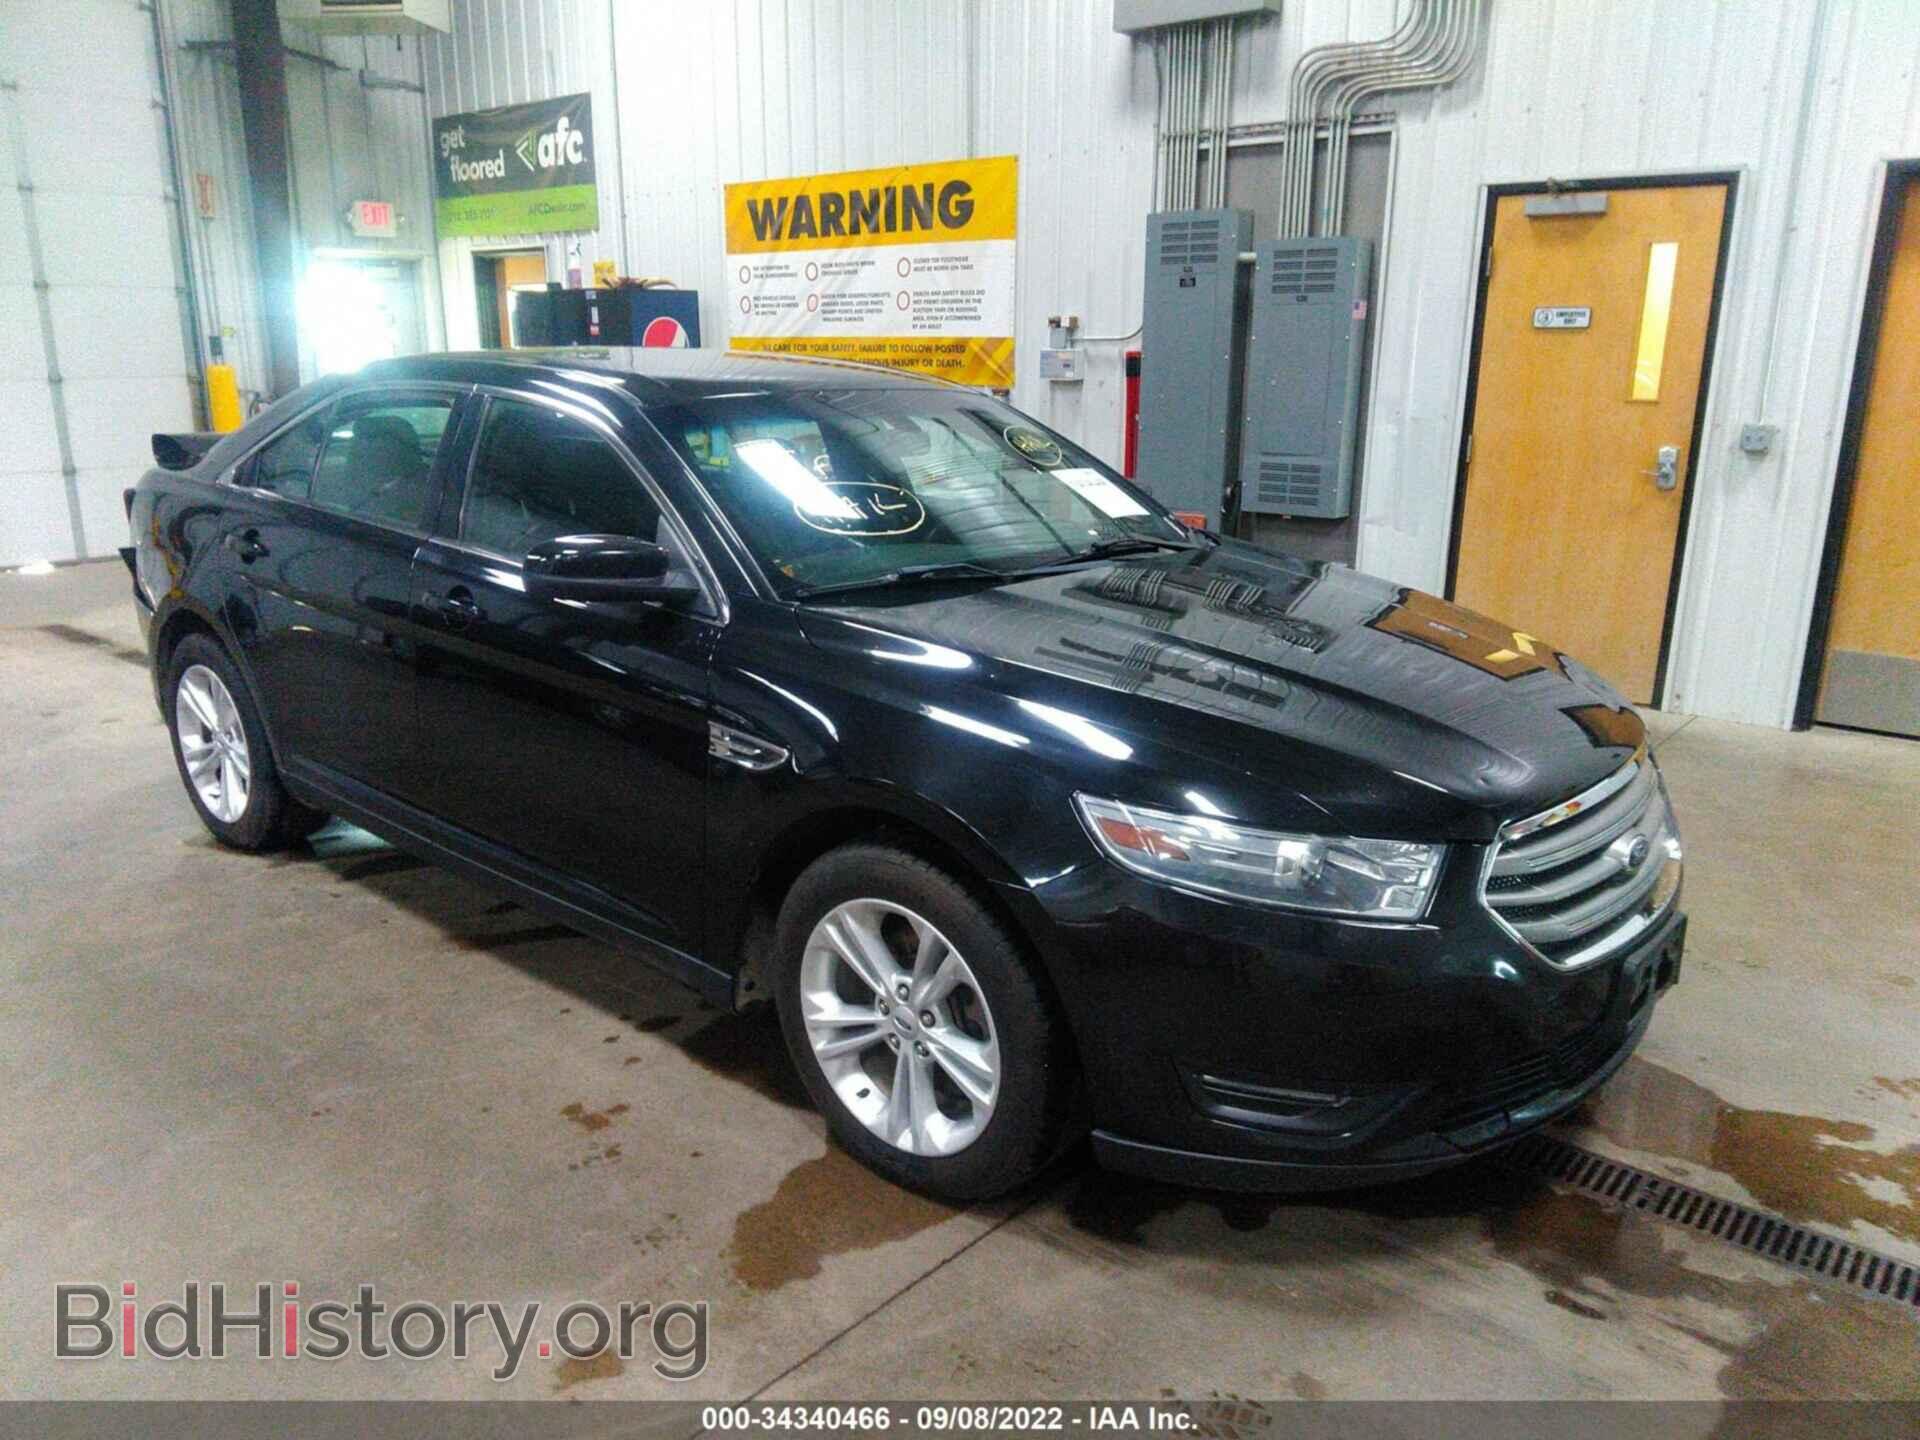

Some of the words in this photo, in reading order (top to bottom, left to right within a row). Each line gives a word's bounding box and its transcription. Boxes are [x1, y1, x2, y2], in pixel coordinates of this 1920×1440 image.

[440, 125, 466, 157] get
[537, 116, 584, 169] afc
[450, 149, 505, 183] floored
[746, 180, 975, 241] WARNING
